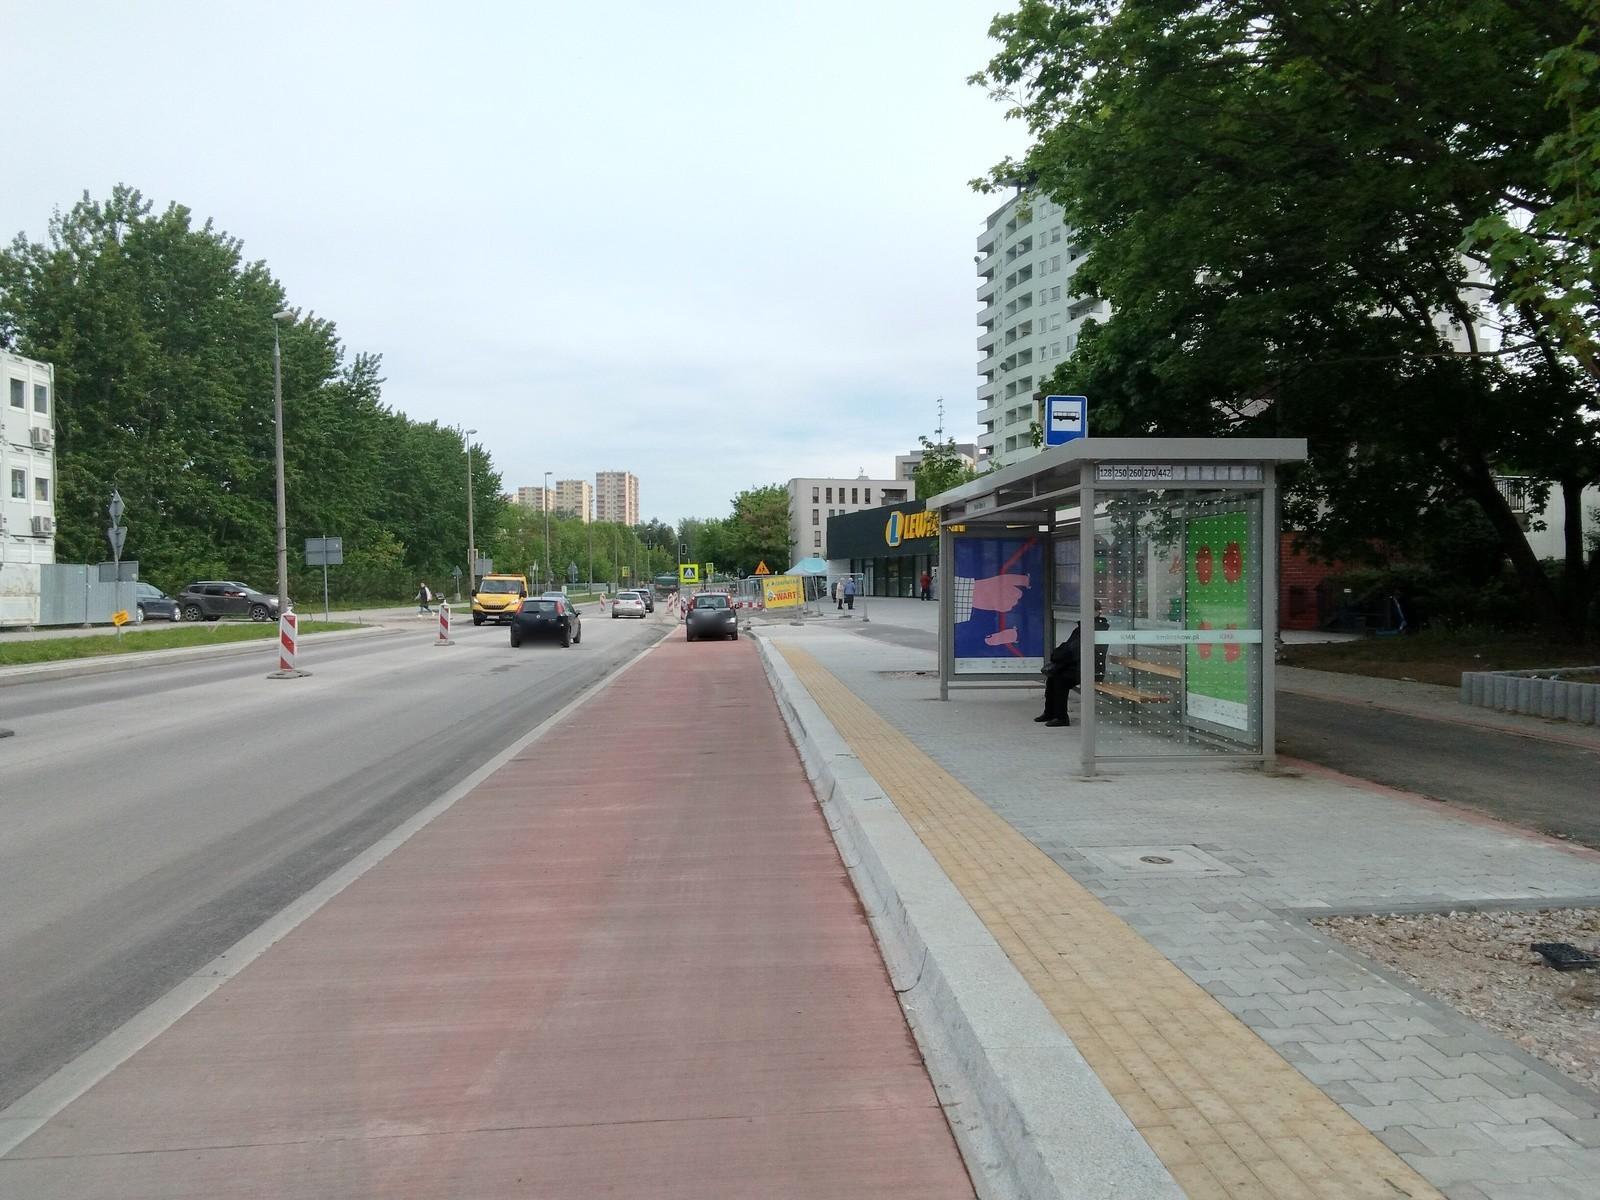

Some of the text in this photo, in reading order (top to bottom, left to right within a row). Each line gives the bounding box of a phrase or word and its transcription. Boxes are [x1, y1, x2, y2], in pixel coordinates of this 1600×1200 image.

[1099, 468, 1171, 478] 128 250 260 270 442
